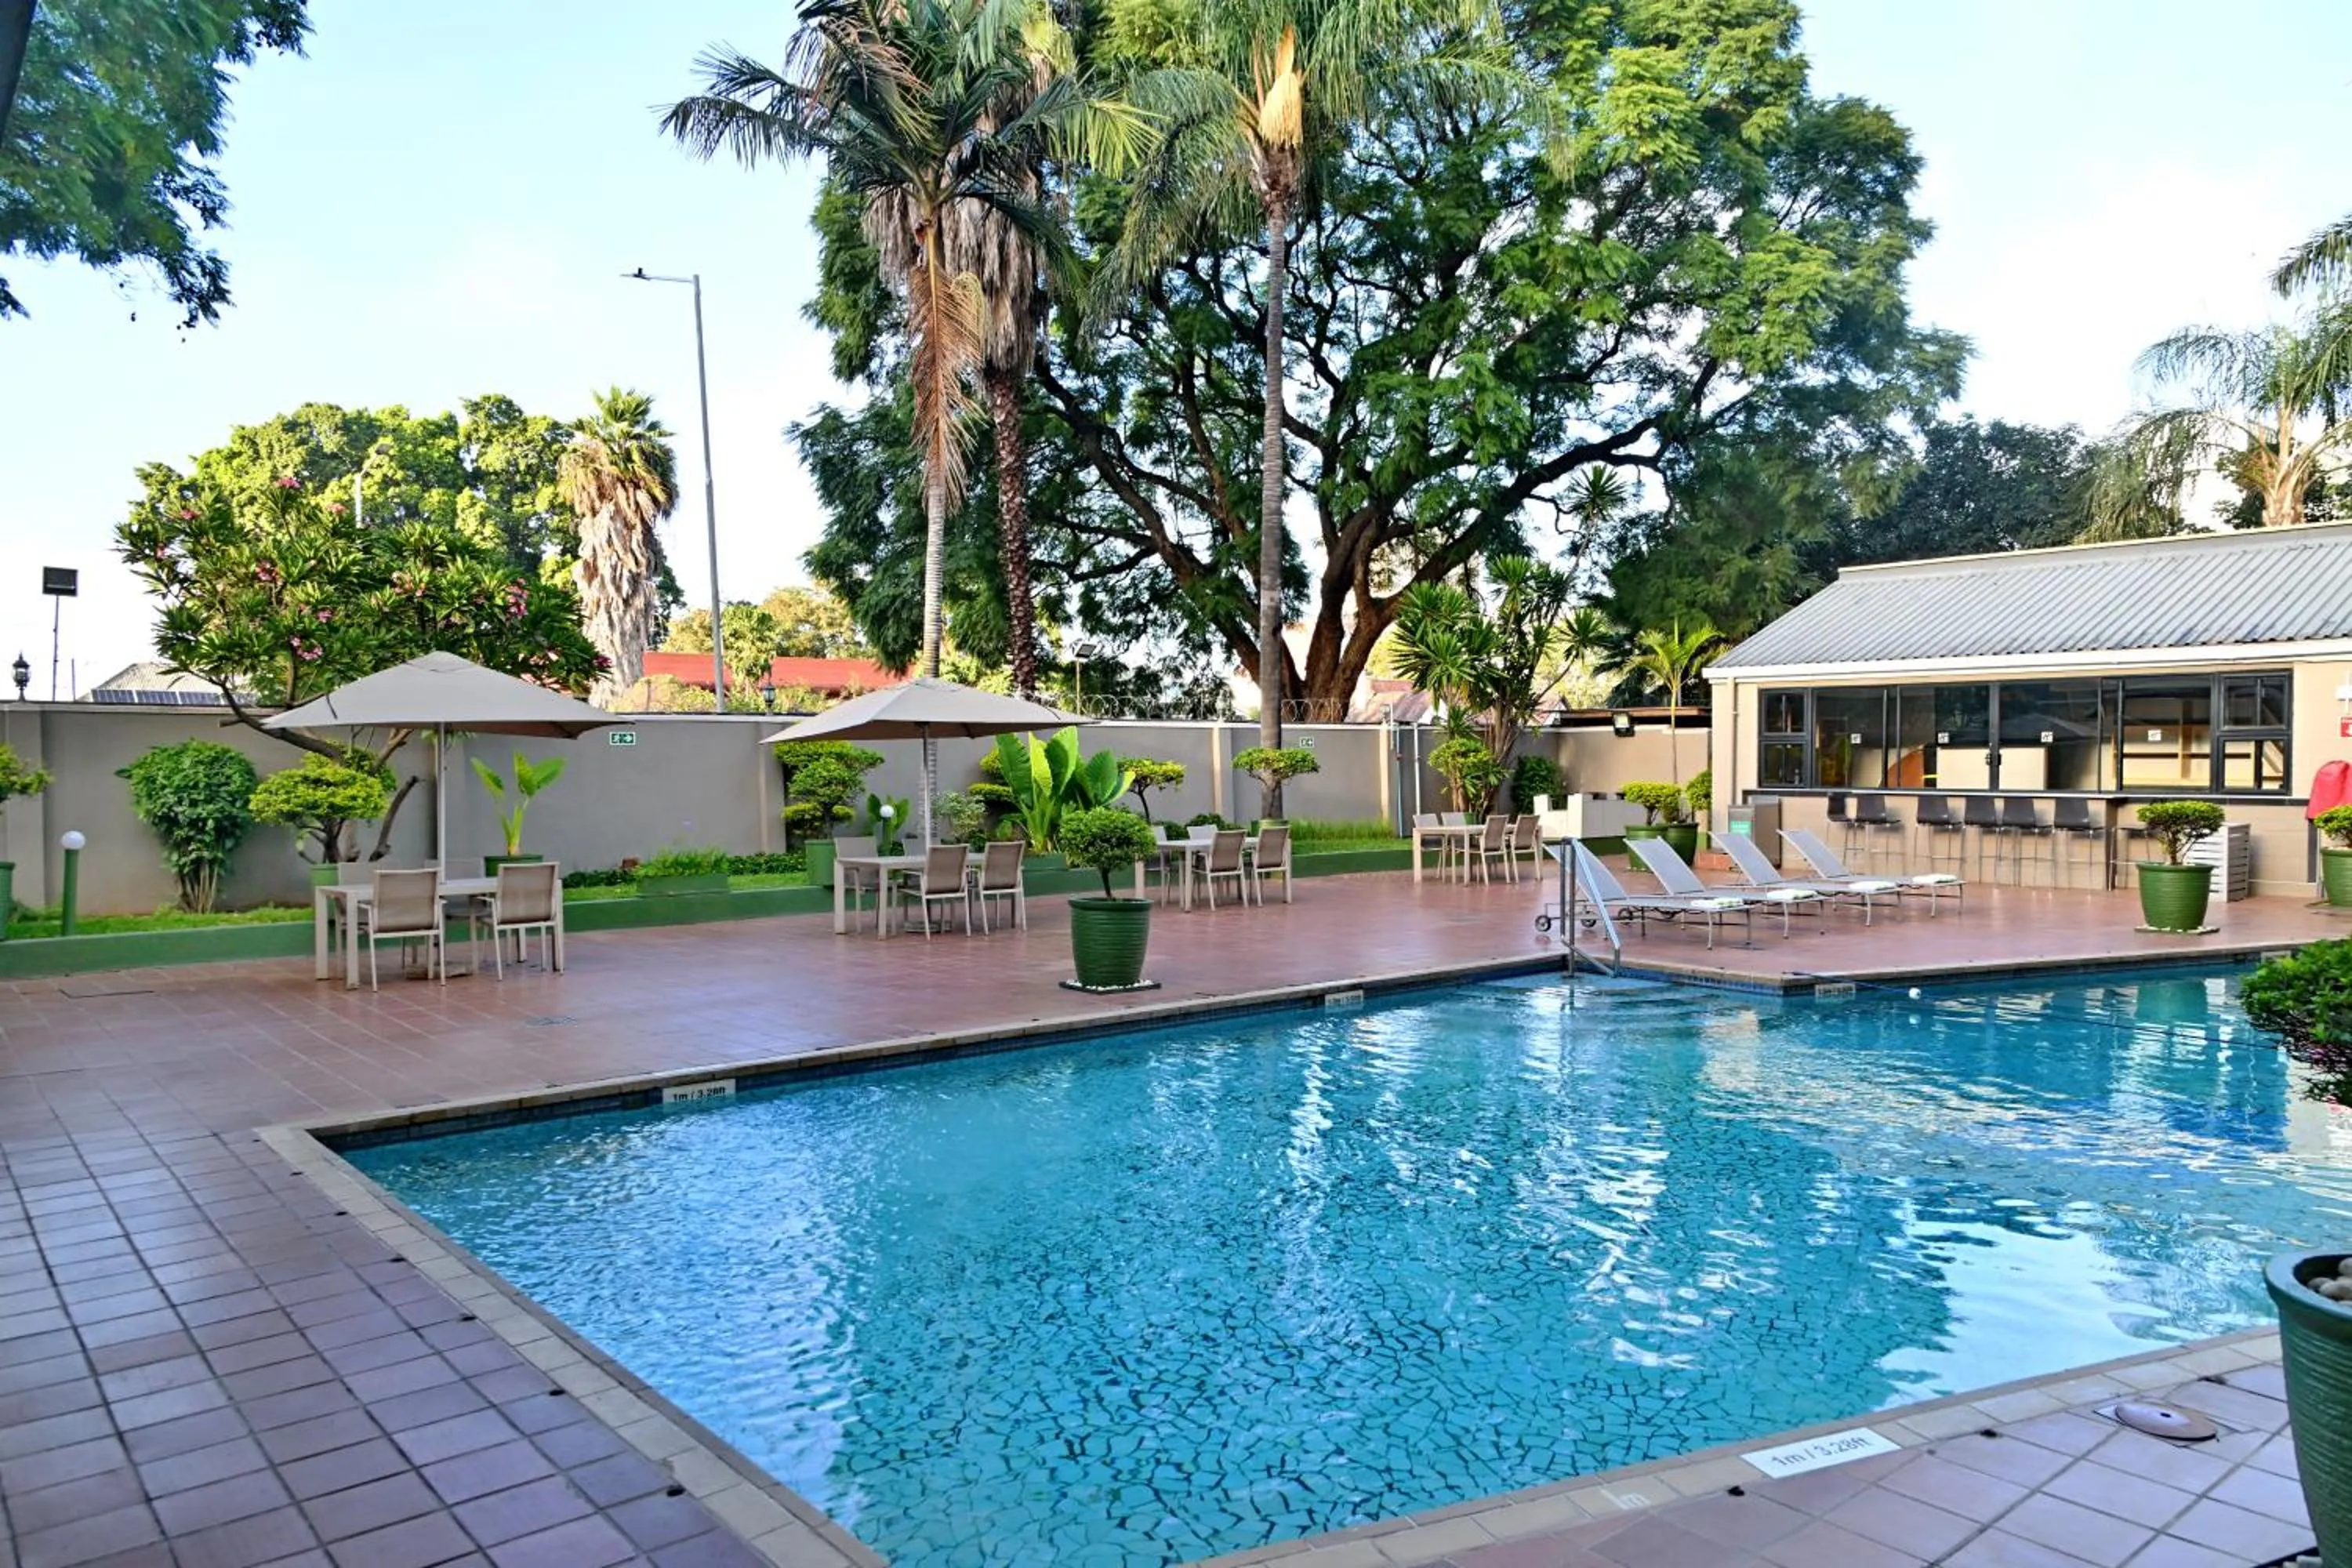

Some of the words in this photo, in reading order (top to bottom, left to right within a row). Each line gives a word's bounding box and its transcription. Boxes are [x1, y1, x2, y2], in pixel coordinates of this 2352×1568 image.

[1771, 1452, 1807, 1466] 1m
[1803, 1448, 1816, 1460] /
[1813, 1436, 1871, 1457] 3.28ft
